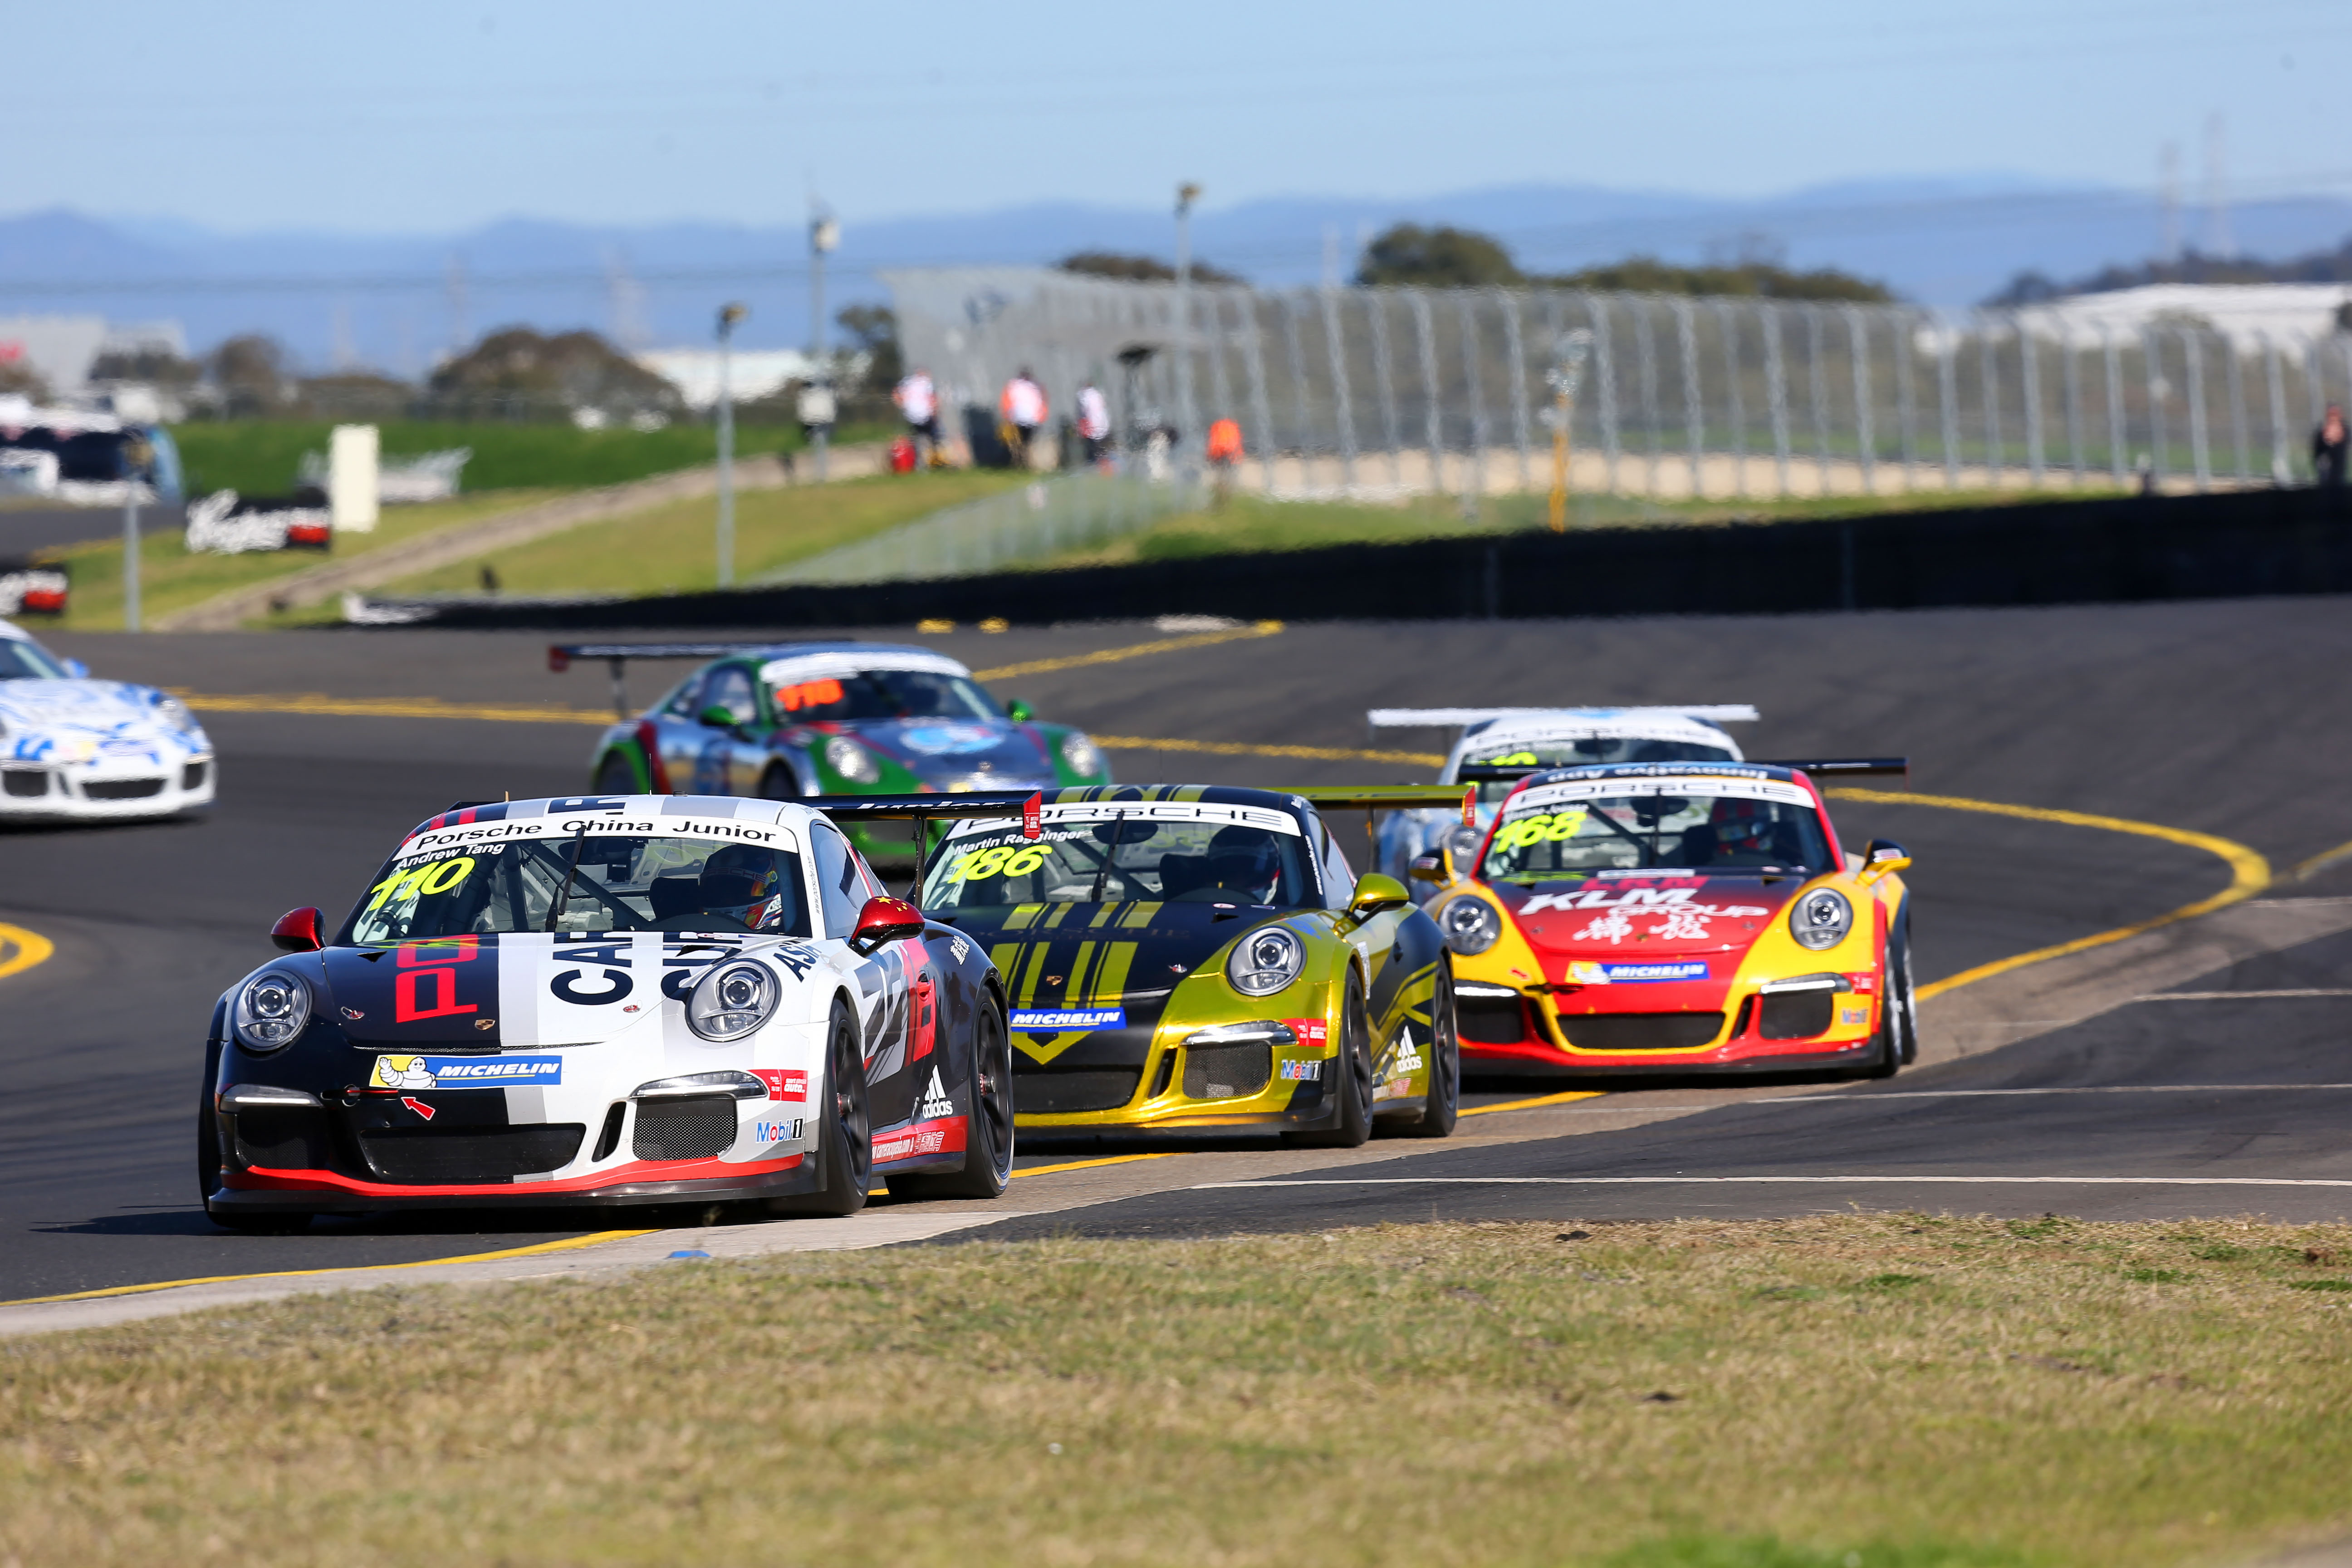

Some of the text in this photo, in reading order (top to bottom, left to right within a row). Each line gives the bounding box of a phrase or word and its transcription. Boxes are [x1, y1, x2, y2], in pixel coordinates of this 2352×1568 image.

[1521, 782, 1797, 802] PORSCHE
[416, 819, 777, 850] Porsche China Junior
[1493, 811, 1587, 853] 168
[399, 843, 506, 868] Andrew Tang
[954, 837, 1000, 856] Martin
[947, 845, 1053, 883] 186
[369, 857, 475, 911] 110
[1518, 888, 1699, 916] KLM
[1611, 964, 1705, 977] MICHELIN
[1011, 1012, 1120, 1024] MICHELIN
[437, 1063, 560, 1077] MICHELIN
[922, 1098, 953, 1119] adidas
[756, 1119, 793, 1143] Mobil
